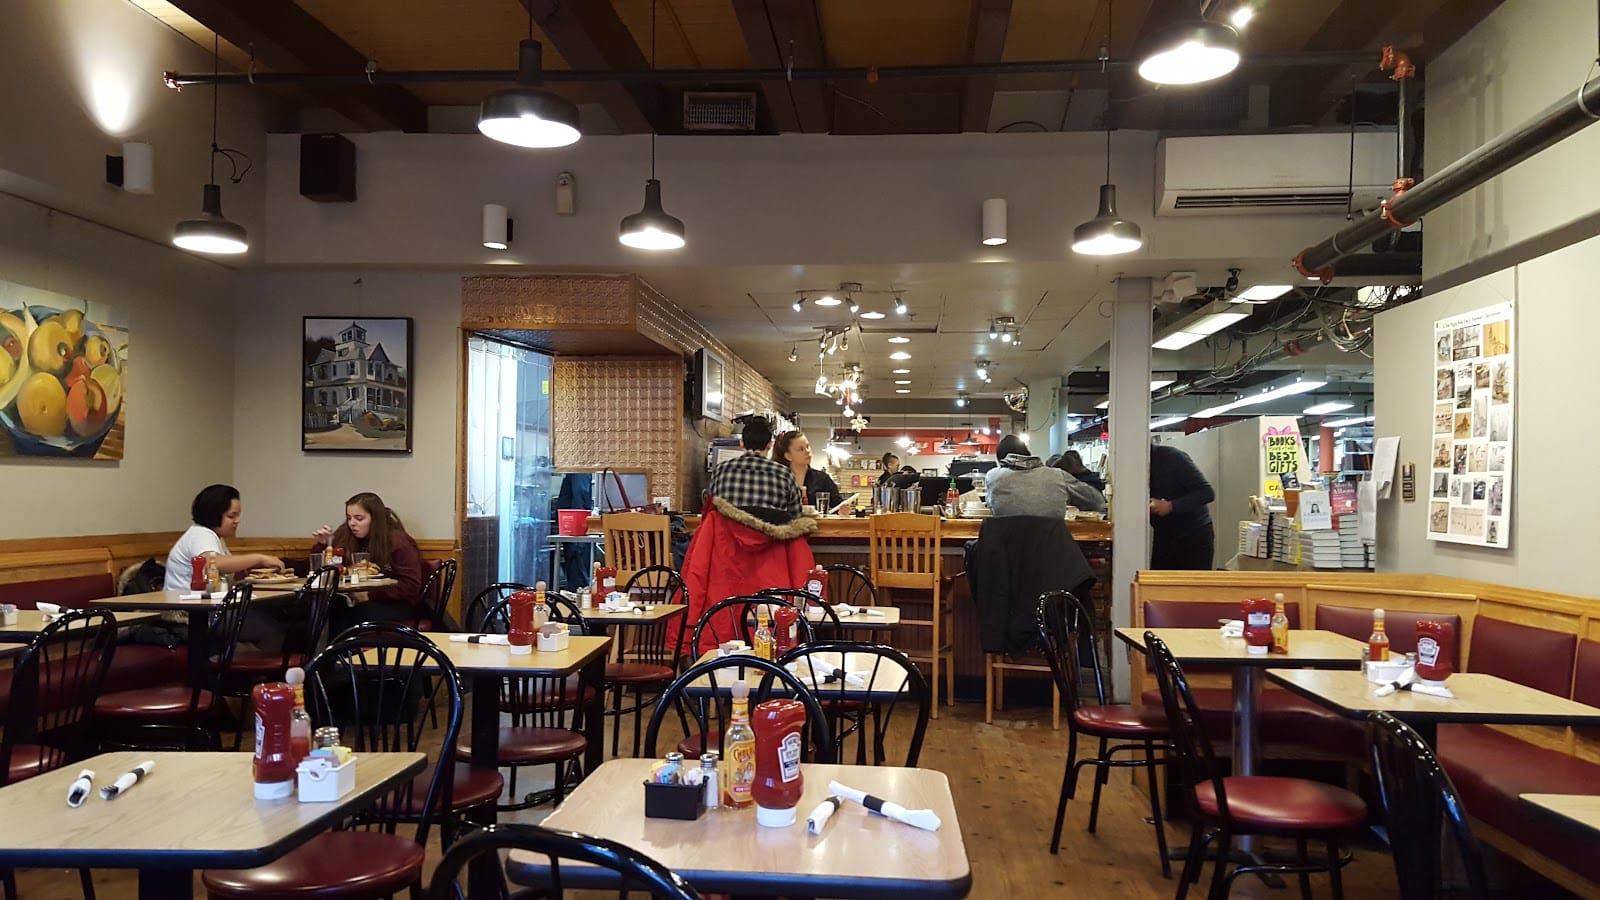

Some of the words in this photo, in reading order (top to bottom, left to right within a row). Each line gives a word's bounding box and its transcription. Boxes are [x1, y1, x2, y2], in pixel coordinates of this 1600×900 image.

[1268, 436, 1296, 447] BOOKS
[1269, 451, 1297, 461] BEST
[1269, 460, 1298, 473] GIFTS
